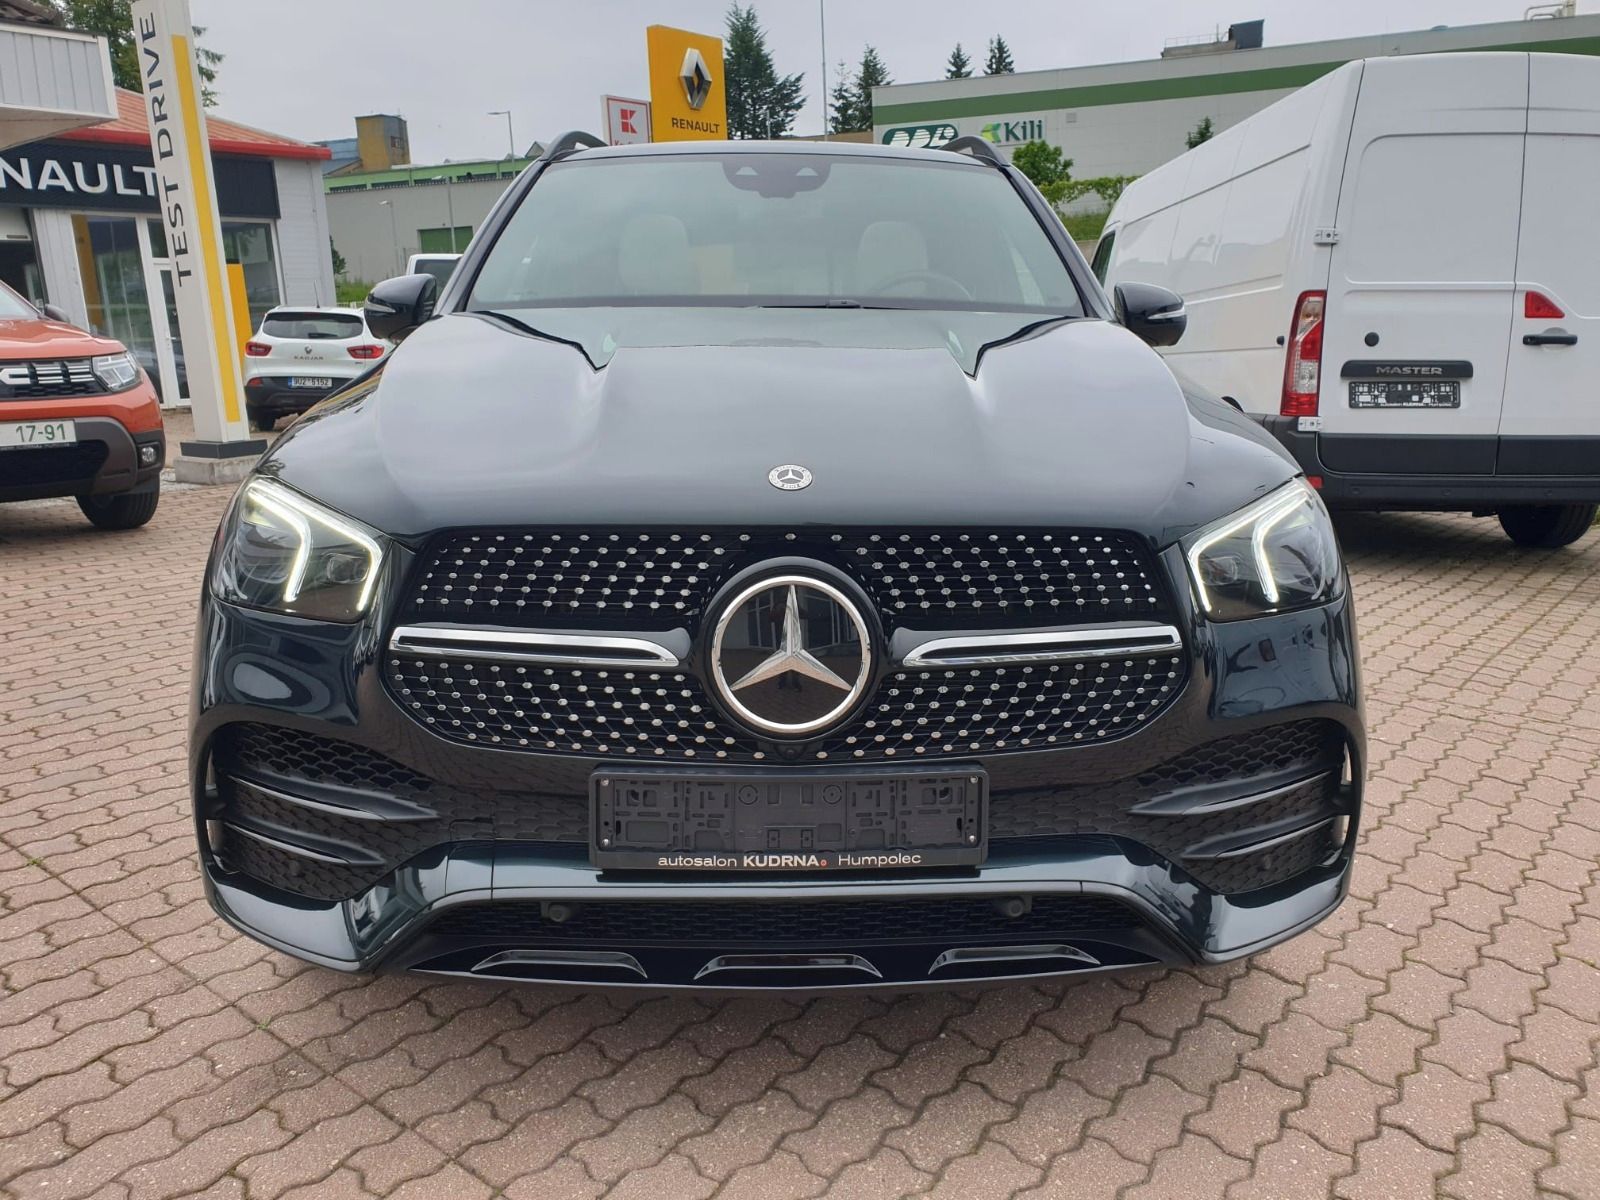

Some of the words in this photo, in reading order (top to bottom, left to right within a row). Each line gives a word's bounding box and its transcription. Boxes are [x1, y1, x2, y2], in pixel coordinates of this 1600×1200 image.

[139, 12, 174, 162] DRIVE
[671, 117, 720, 134] RENAULT
[1004, 119, 1043, 142] Kili
[163, 175, 192, 287] TEST
[1375, 366, 1443, 375] MASTER
[15, 423, 66, 443] 17-91
[657, 855, 738, 868] autosalon
[743, 854, 820, 868] KUDRNA
[838, 853, 922, 869] Humpolec
